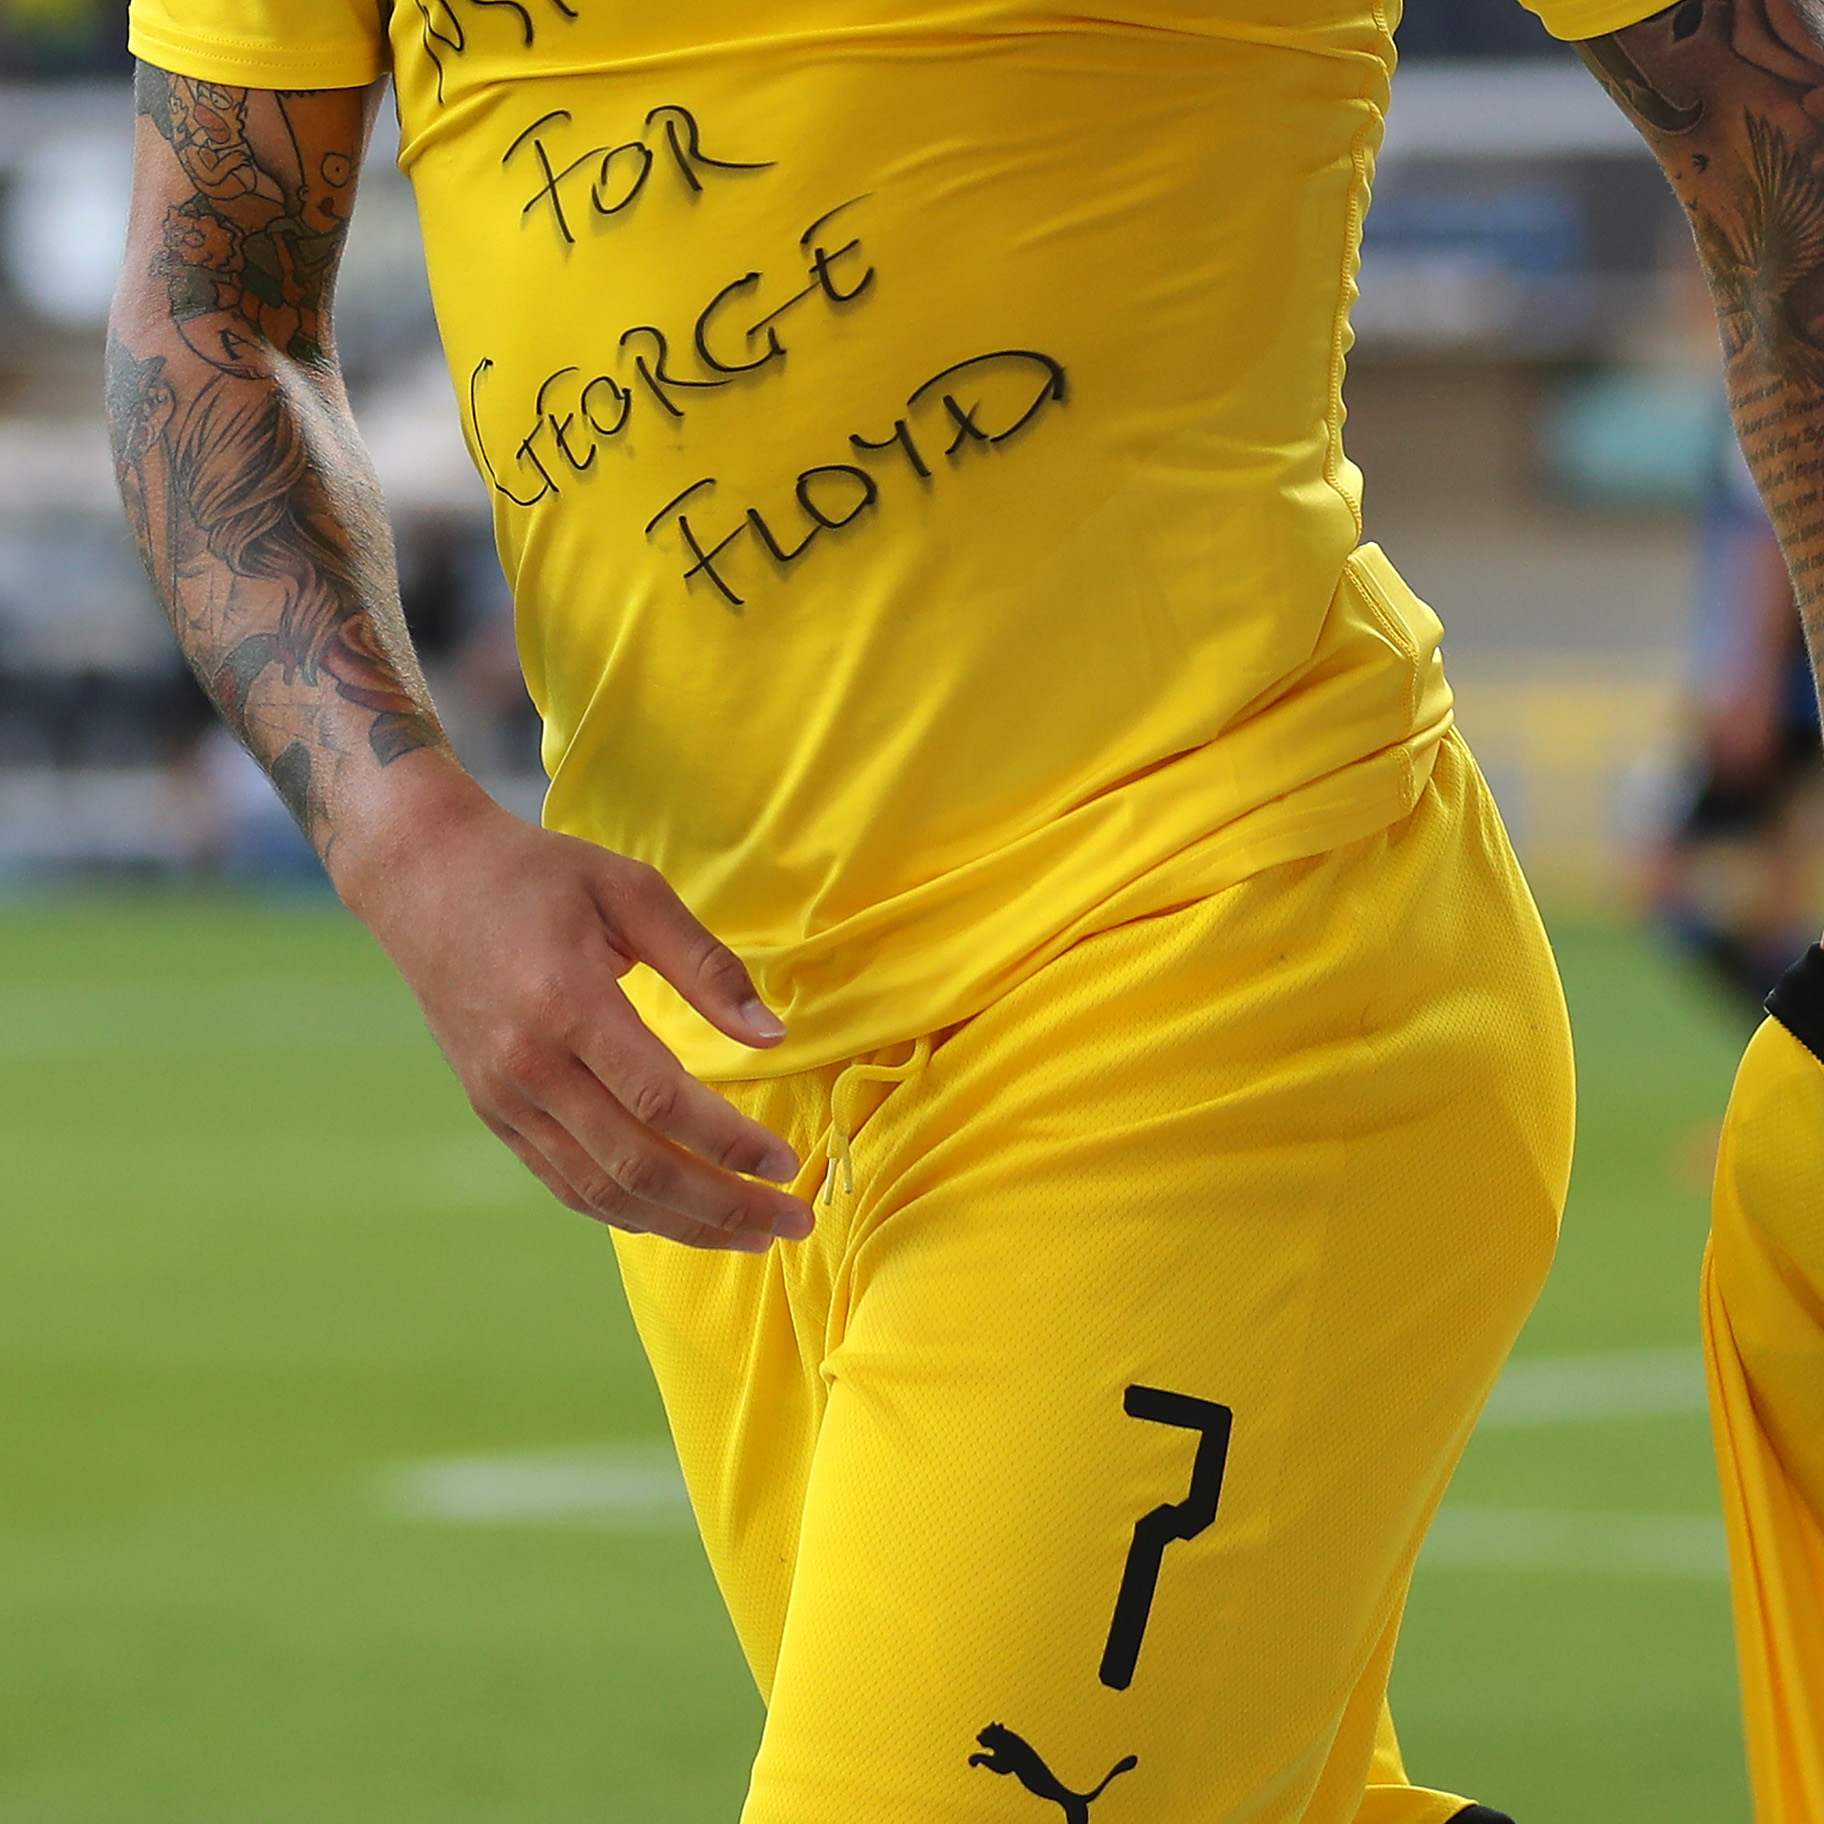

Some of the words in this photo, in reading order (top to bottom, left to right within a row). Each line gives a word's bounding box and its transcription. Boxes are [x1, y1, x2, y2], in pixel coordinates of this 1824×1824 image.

[501, 104, 779, 245] FOR
[470, 193, 875, 507] GEORGE
[644, 349, 1066, 606] FLOYD
[1098, 1383, 1233, 1691] 7
